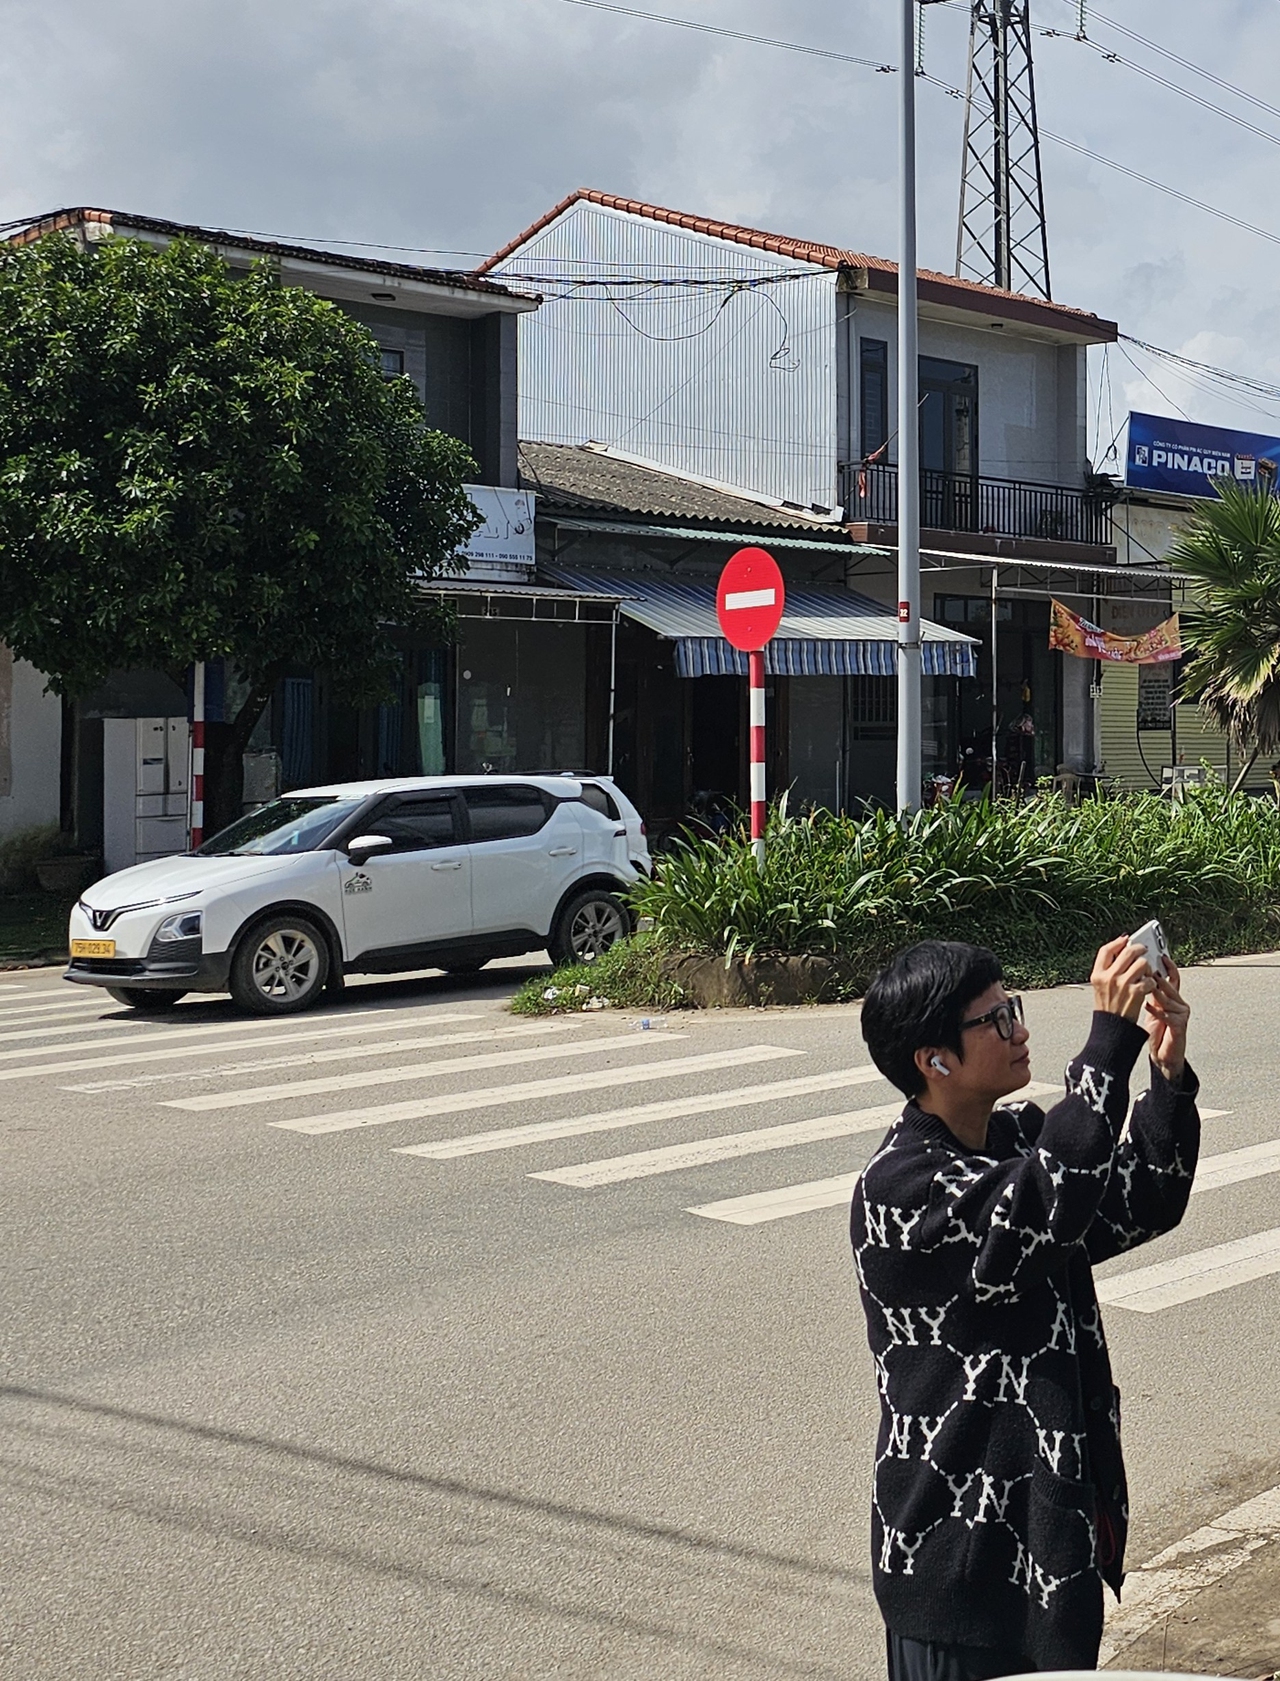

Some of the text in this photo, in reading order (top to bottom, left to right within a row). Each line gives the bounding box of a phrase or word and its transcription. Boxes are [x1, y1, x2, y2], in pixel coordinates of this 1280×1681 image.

[1152, 449, 1230, 477] PINACO
[882, 1307, 947, 1346] NY
[885, 1413, 945, 1460] NY
